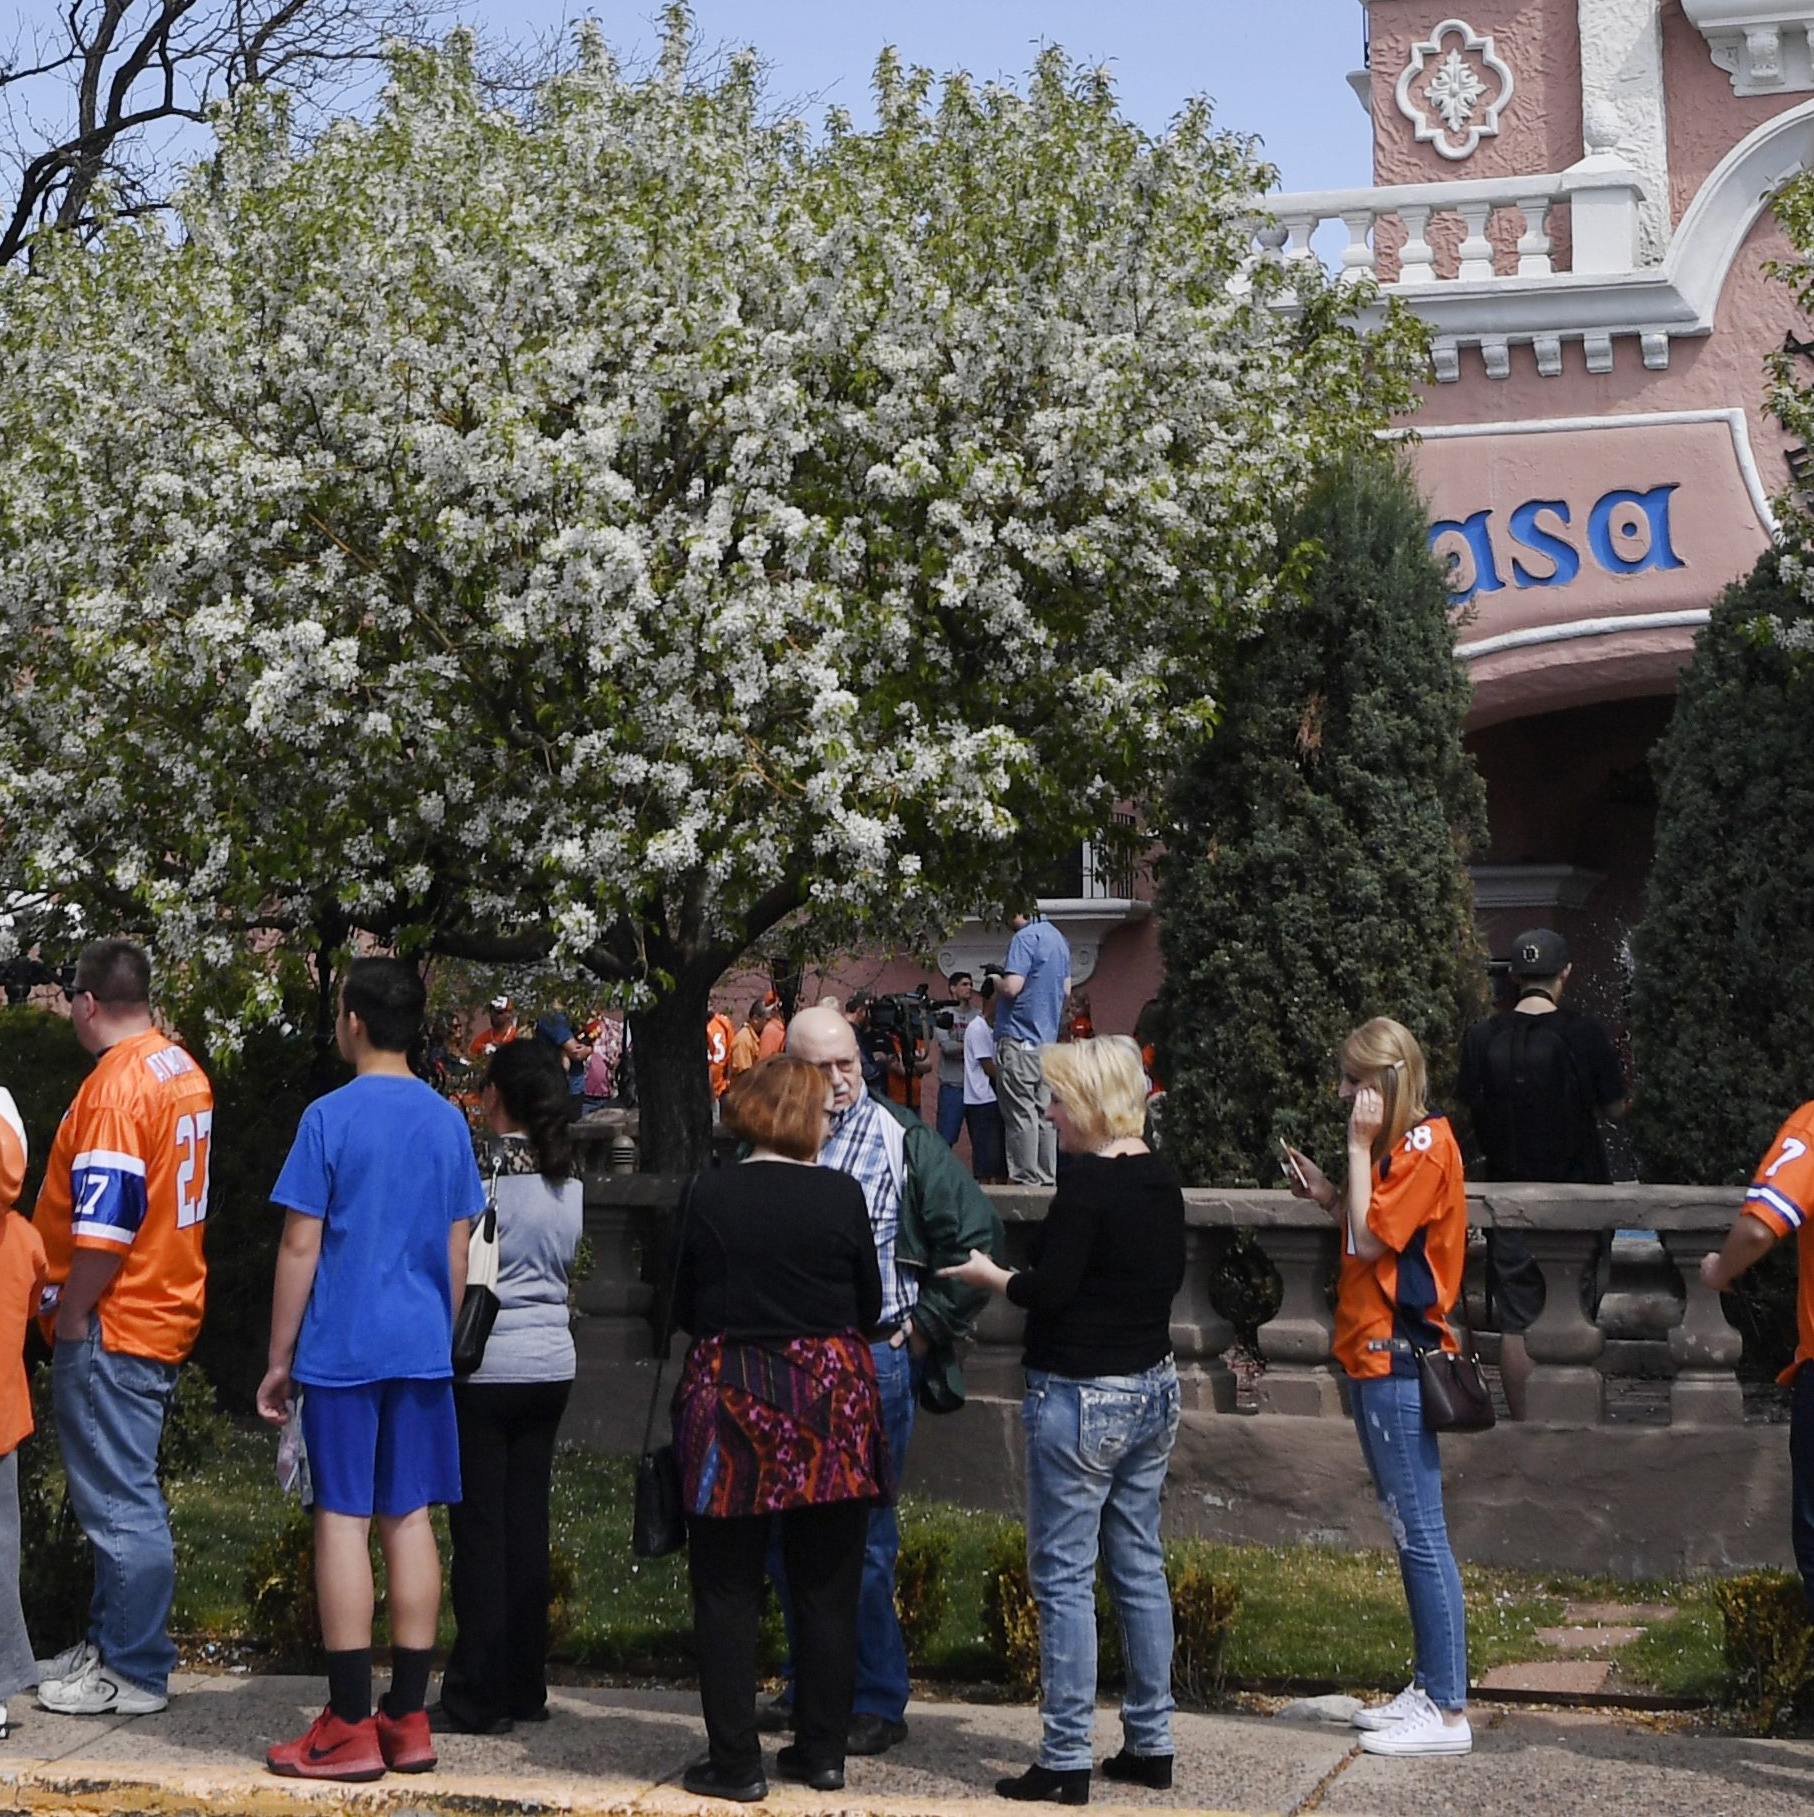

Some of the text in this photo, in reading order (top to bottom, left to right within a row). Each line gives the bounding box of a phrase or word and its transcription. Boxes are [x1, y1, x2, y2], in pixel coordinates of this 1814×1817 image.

[1429, 482, 1686, 604] asa
[175, 1109, 214, 1229] 27
[1764, 1137, 1807, 1177] 7
